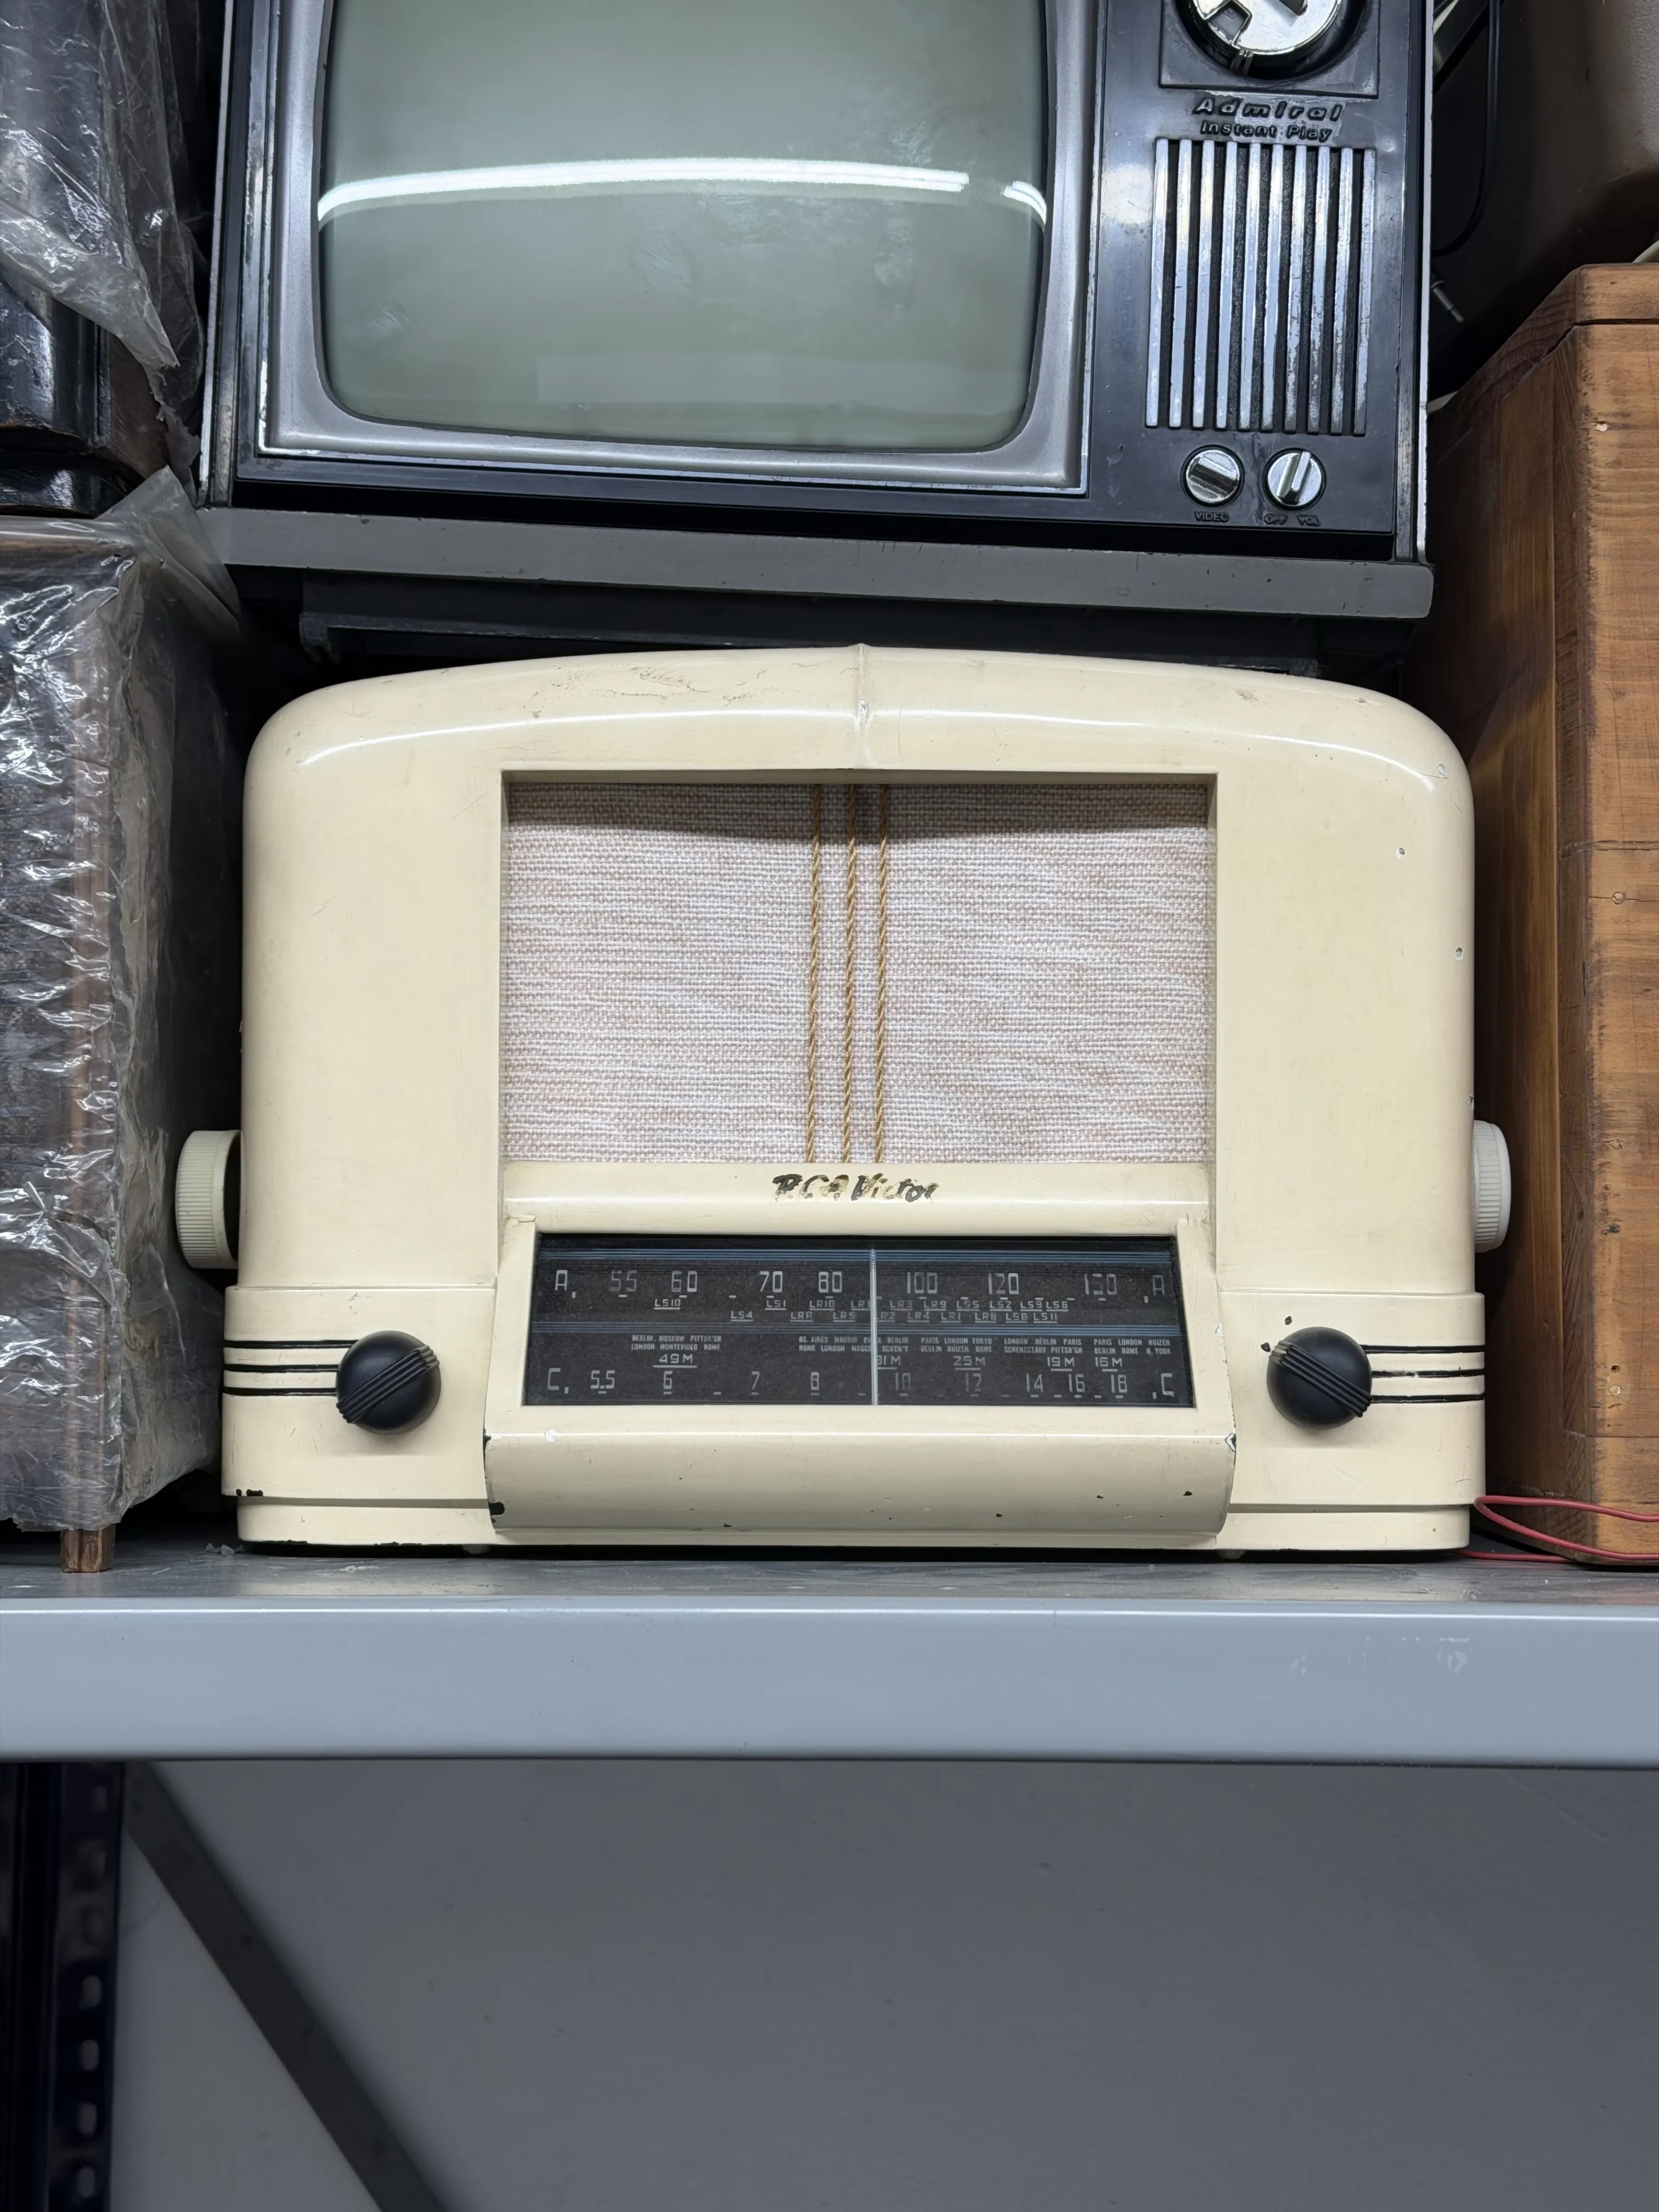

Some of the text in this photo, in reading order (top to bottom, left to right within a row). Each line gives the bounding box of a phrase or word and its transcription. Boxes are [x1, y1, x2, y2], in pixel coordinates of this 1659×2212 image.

[1200, 121, 1332, 142] Instant Play
[1194, 511, 1229, 522] VIDEO
[850, 1173, 939, 1203] Victor
[610, 1270, 637, 1291] 55
[671, 1271, 697, 1293] 60
[759, 1271, 782, 1293] 70
[819, 1271, 842, 1293] 80
[907, 1272, 938, 1294] 100
[988, 1272, 1019, 1295] 120
[924, 1300, 946, 1308] LR9
[731, 1311, 753, 1319] LS4
[663, 1370, 673, 1390] 6
[751, 1371, 760, 1390] 7
[810, 1372, 820, 1390] 8
[965, 1372, 981, 1391] 12
[1026, 1373, 1043, 1392] 14
[1069, 1374, 1085, 1392] 16
[1111, 1374, 1127, 1393] 18
